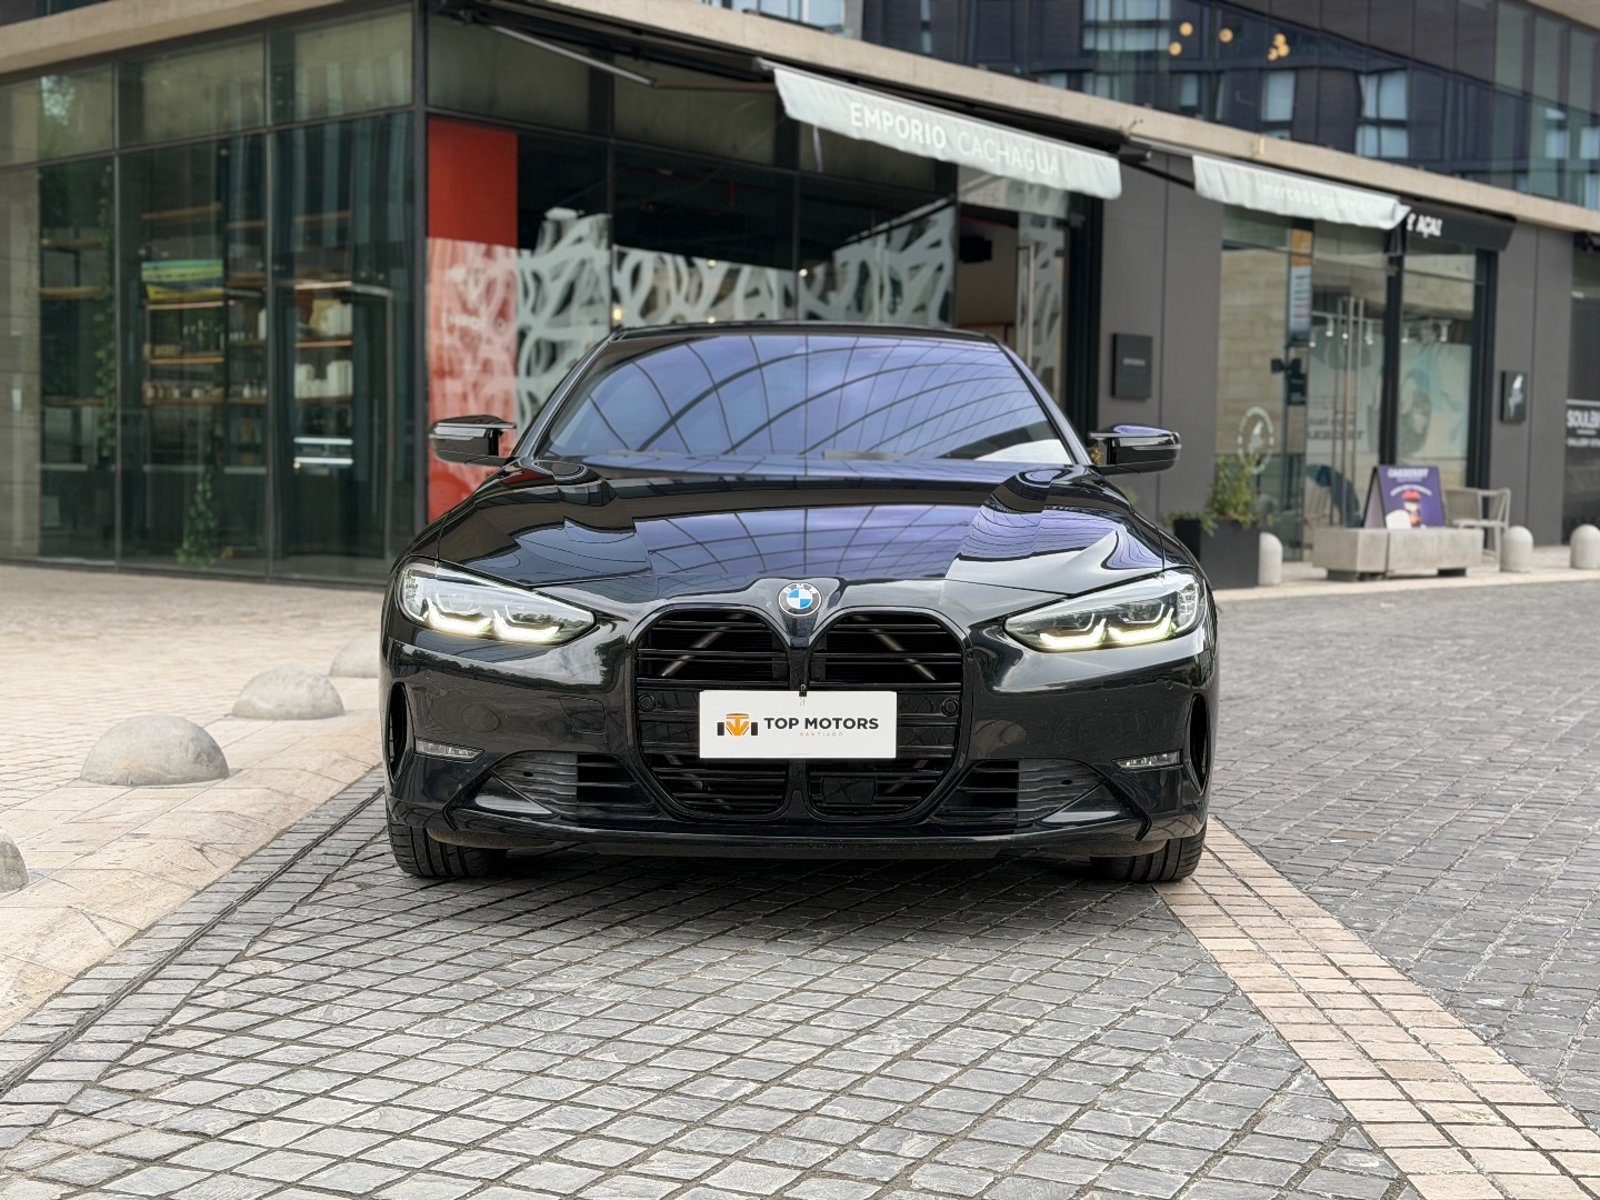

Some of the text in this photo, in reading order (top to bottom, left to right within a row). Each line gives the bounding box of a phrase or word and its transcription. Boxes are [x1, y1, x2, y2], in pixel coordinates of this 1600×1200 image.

[850, 103, 1060, 176] EMPORIO CACHAGUA
[783, 582, 818, 594] BMW
[764, 717, 879, 730] TOP MOTORS
